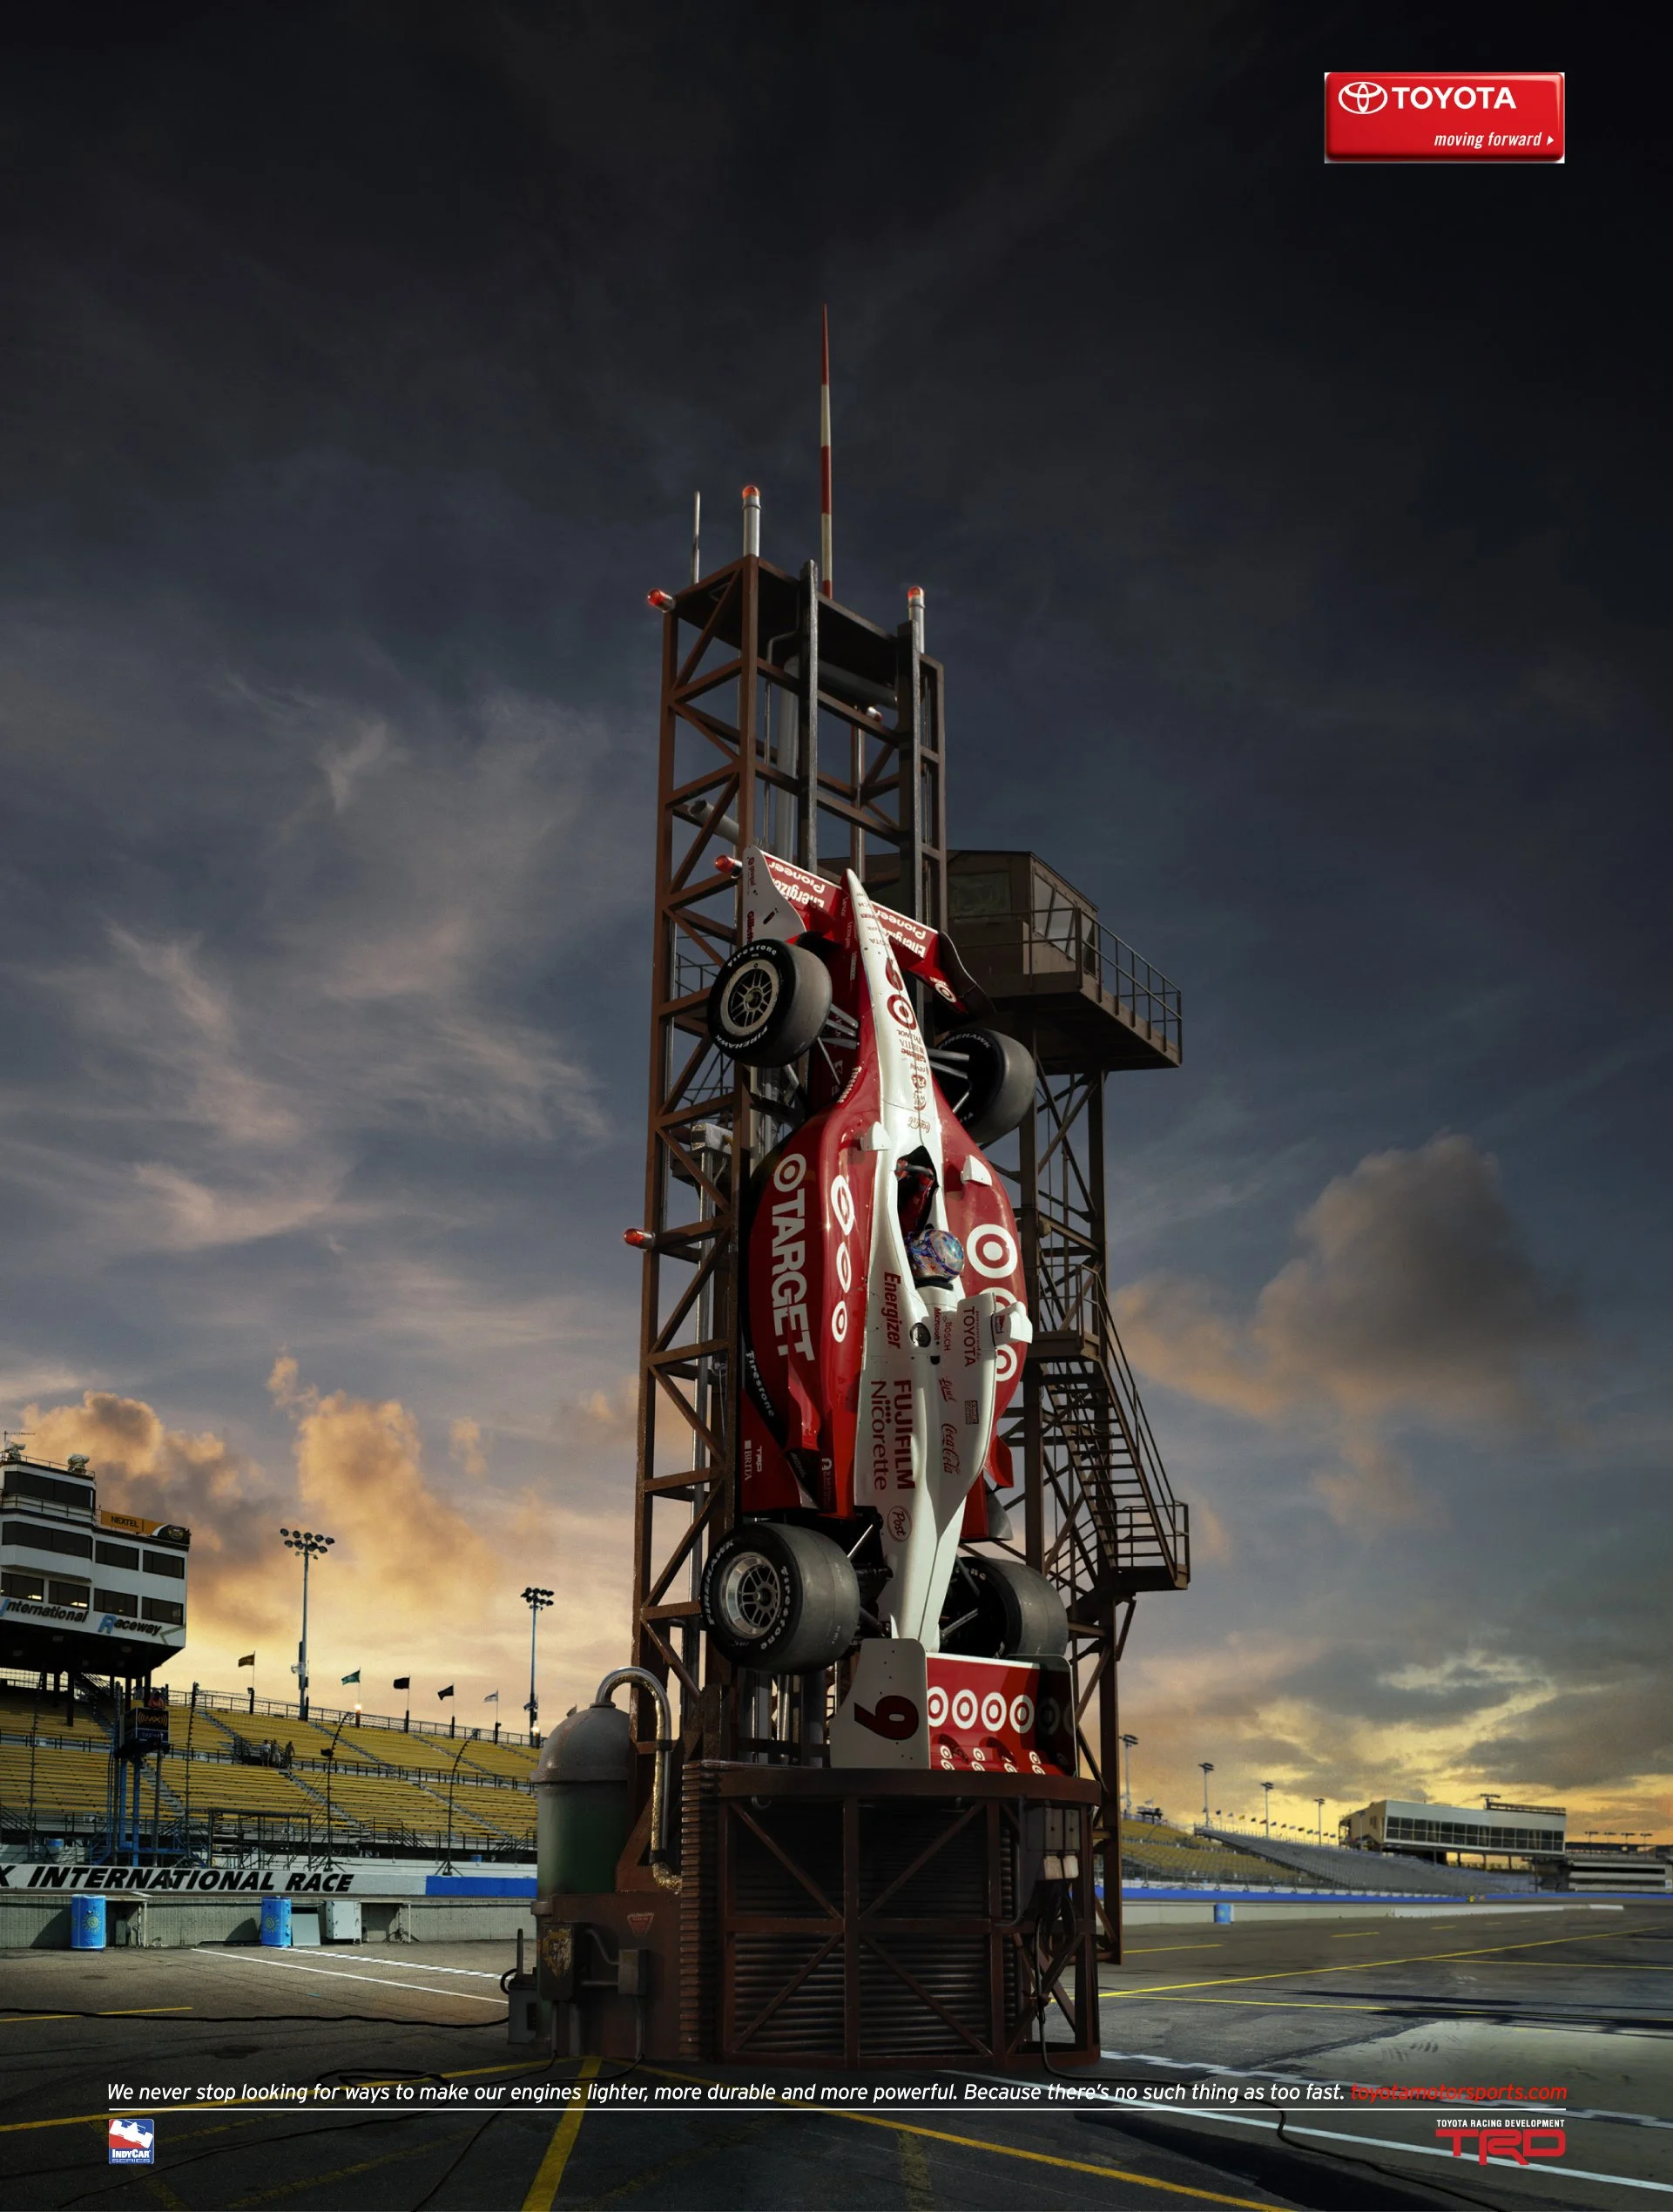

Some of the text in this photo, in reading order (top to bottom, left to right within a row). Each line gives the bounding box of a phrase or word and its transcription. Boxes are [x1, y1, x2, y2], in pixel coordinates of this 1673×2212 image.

[768, 861, 826, 894] Pioneer
[772, 879, 825, 908] Energize
[875, 907, 927, 941] Pioneer
[726, 944, 778, 968] Firestone
[715, 1024, 768, 1049] FIREHAWK
[771, 1187, 815, 1361] TARGET
[884, 1271, 901, 1349] Energizer
[944, 1321, 953, 1352] BOSCH
[963, 1306, 975, 1367] TOYOTA
[745, 1350, 774, 1418] Firestone
[870, 1380, 889, 1491] Nicorette
[894, 1379, 915, 1490] FUJIFILM
[744, 1450, 752, 1481] BRITA
[111, 1515, 139, 1528] NEXTEL
[893, 1511, 906, 1536] Post
[704, 1539, 735, 1625] FIREHAWK
[0, 1598, 162, 1635] International Raceway
[760, 1565, 791, 1650] Firestone
[27, 1865, 275, 1892] INTERNATIONAL
[286, 1873, 354, 1893] RACE
